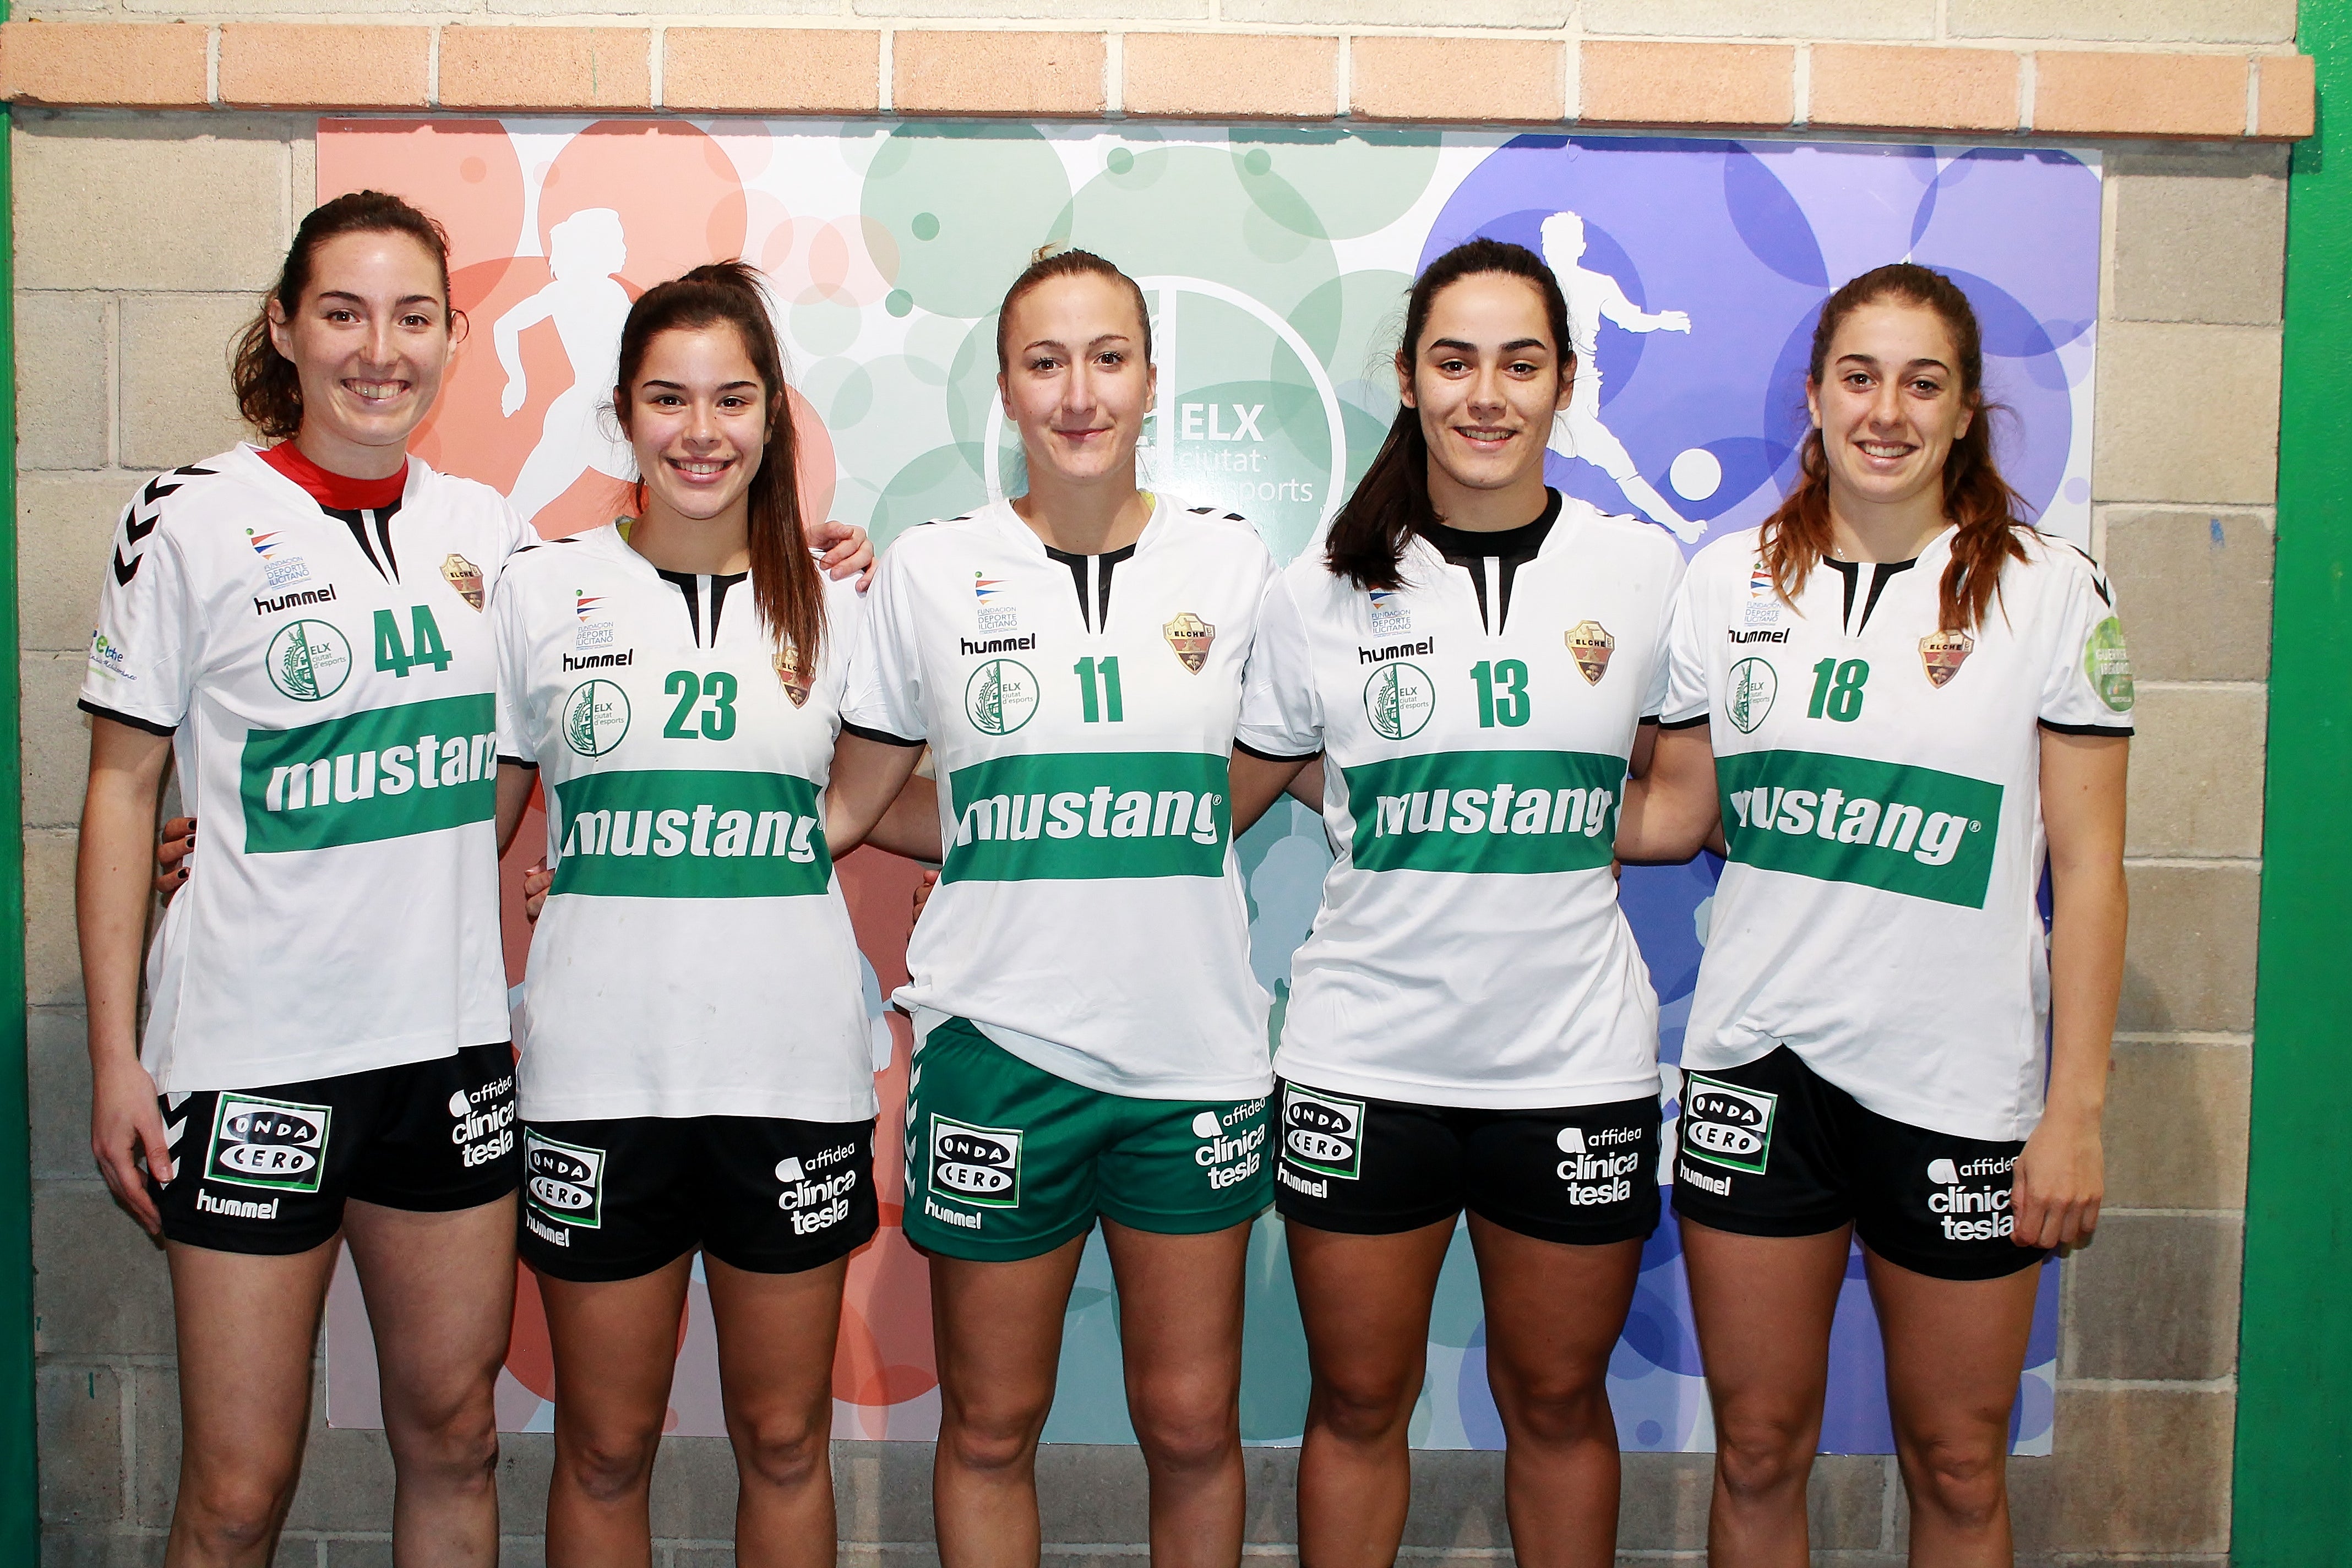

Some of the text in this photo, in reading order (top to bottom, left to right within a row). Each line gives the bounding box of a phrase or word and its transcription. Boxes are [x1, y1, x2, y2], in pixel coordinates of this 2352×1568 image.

[1182, 402, 1265, 442] ELX
[266, 563, 307, 579] DEPORTE
[269, 569, 309, 586] ILICITANO
[253, 584, 336, 616] hummel
[978, 613, 1017, 624] DEPORTE
[979, 620, 1017, 630] ILICITANO
[1373, 617, 1411, 628] DEPORTE
[1373, 623, 1411, 634] ILICITANO
[373, 605, 453, 678] 44
[576, 636, 613, 646] ILICITANO
[577, 629, 613, 639] DEPORTE
[961, 633, 1035, 655] hummel
[1576, 639, 1605, 647] ELCHE
[1728, 625, 1790, 644] hummel
[310, 642, 331, 655] ELX
[312, 653, 333, 662] ciutat
[563, 648, 633, 672] hummel
[1358, 636, 1433, 665] hummel
[313, 656, 346, 669] d'esports
[1003, 682, 1021, 692] ELX
[1073, 656, 1124, 723] 11
[1400, 687, 1418, 696] ELX
[1470, 659, 1531, 728] 13
[1750, 682, 1765, 691] ELX
[1806, 658, 1869, 722] 18
[595, 703, 613, 712] ELX
[663, 670, 738, 741] 23
[1003, 696, 1033, 705] d'esports
[1400, 701, 1429, 710] d'esports
[594, 717, 624, 726] d'esports
[956, 786, 1218, 847] mustang
[1375, 783, 1613, 837] mustang
[562, 804, 817, 863] mustang
[470, 1075, 512, 1103] affidea
[1223, 1097, 1266, 1126] affidea
[1293, 1106, 1343, 1130] ONDA
[1696, 1097, 1754, 1122] ONDA
[236, 1117, 308, 1139] ONDA
[453, 1100, 514, 1145] clínica
[462, 1129, 513, 1167] tesla
[1195, 1123, 1265, 1166] clínica
[1294, 1133, 1342, 1157] CERO
[1588, 1127, 1642, 1146] affidea
[1696, 1125, 1750, 1150] CERO
[234, 1148, 303, 1169] CERO
[805, 1142, 854, 1170] affidea
[944, 1138, 1002, 1161] ONDA
[534, 1152, 583, 1178] ONDA
[945, 1166, 1000, 1188] CERO
[1207, 1152, 1260, 1190] tesla
[1557, 1152, 1638, 1180] clínica
[1680, 1158, 1731, 1196] hummel
[536, 1179, 581, 1205] CERO
[778, 1170, 856, 1210] clínica
[1277, 1162, 1327, 1199] hummel
[1567, 1177, 1630, 1205] tesla
[197, 1188, 279, 1219] hummel
[1928, 1185, 2012, 1213] clínic
[791, 1197, 848, 1235] tesla
[924, 1196, 982, 1229] hummel
[526, 1208, 570, 1247] hummel
[1941, 1212, 2015, 1241] tesla
